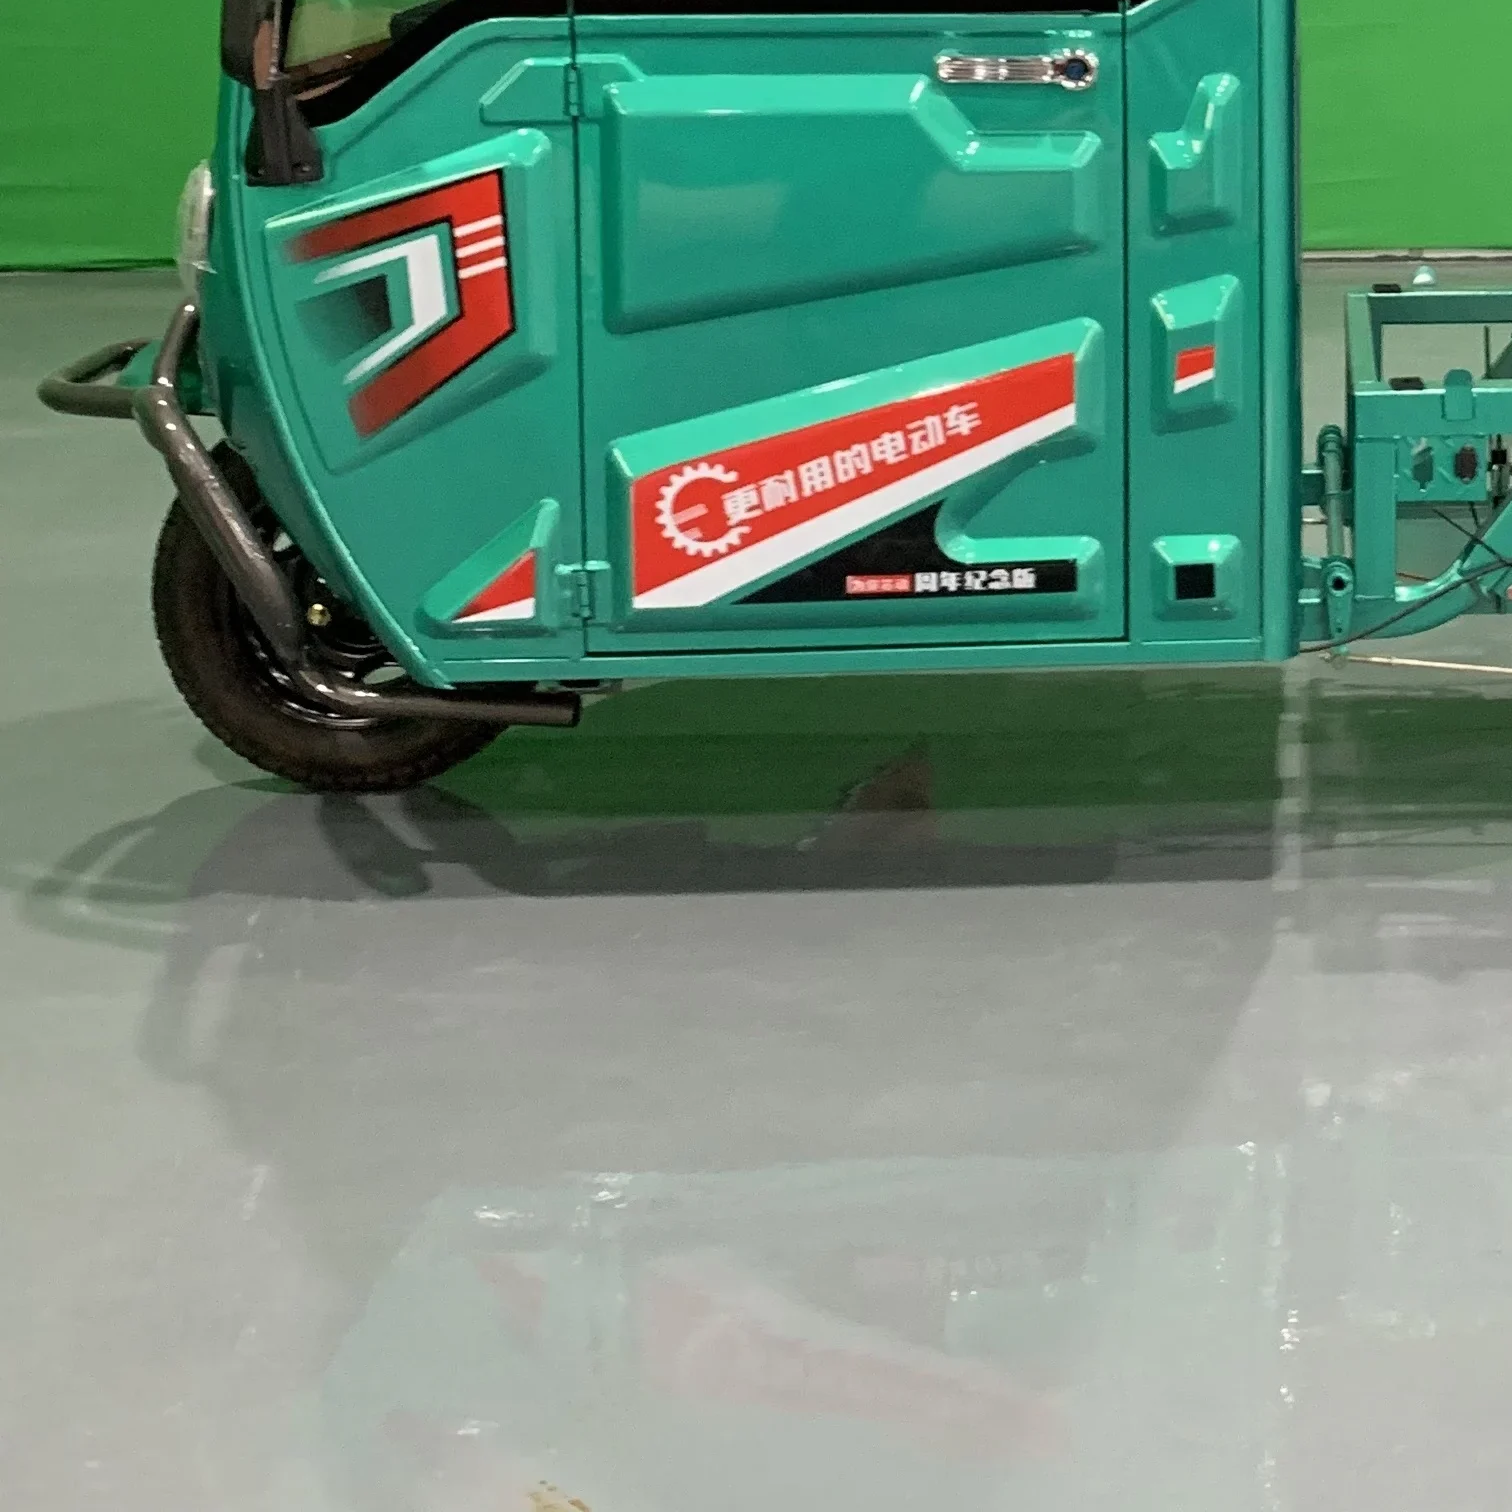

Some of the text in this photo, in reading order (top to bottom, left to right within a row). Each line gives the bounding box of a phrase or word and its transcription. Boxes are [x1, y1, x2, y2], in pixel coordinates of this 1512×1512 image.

[723, 402, 982, 524] 更耐用的电动车
